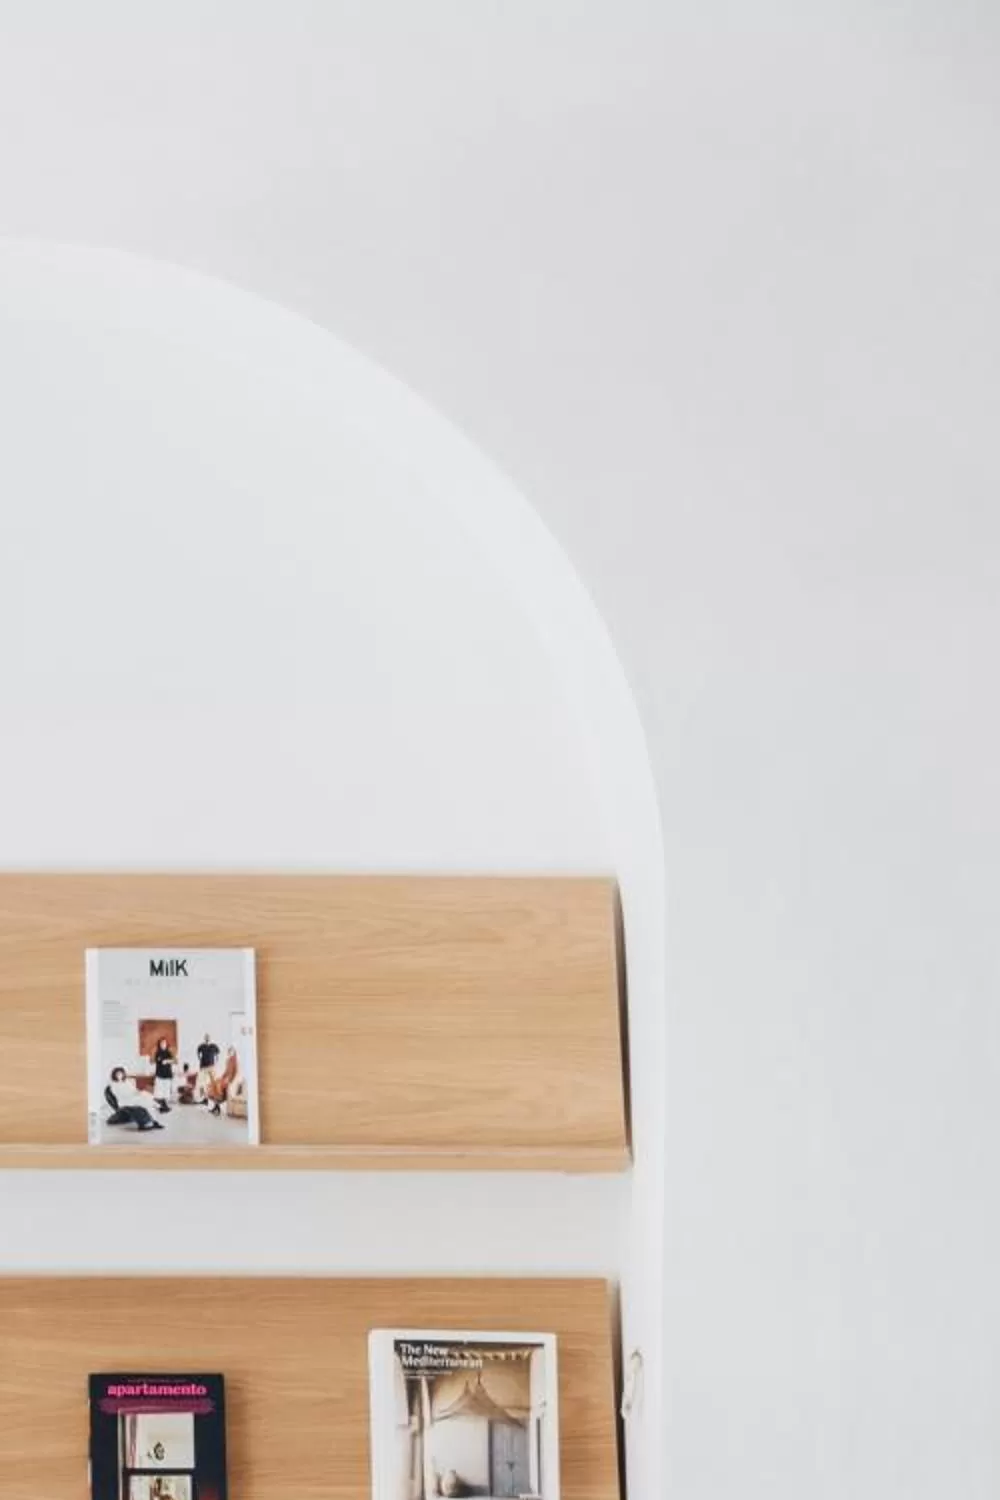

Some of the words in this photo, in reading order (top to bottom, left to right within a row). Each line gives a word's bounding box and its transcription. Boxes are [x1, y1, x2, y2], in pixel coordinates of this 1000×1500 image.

[149, 959, 189, 977] MilK
[399, 1343, 422, 1355] The
[423, 1344, 449, 1356] New
[107, 1383, 208, 1397] apartamento
